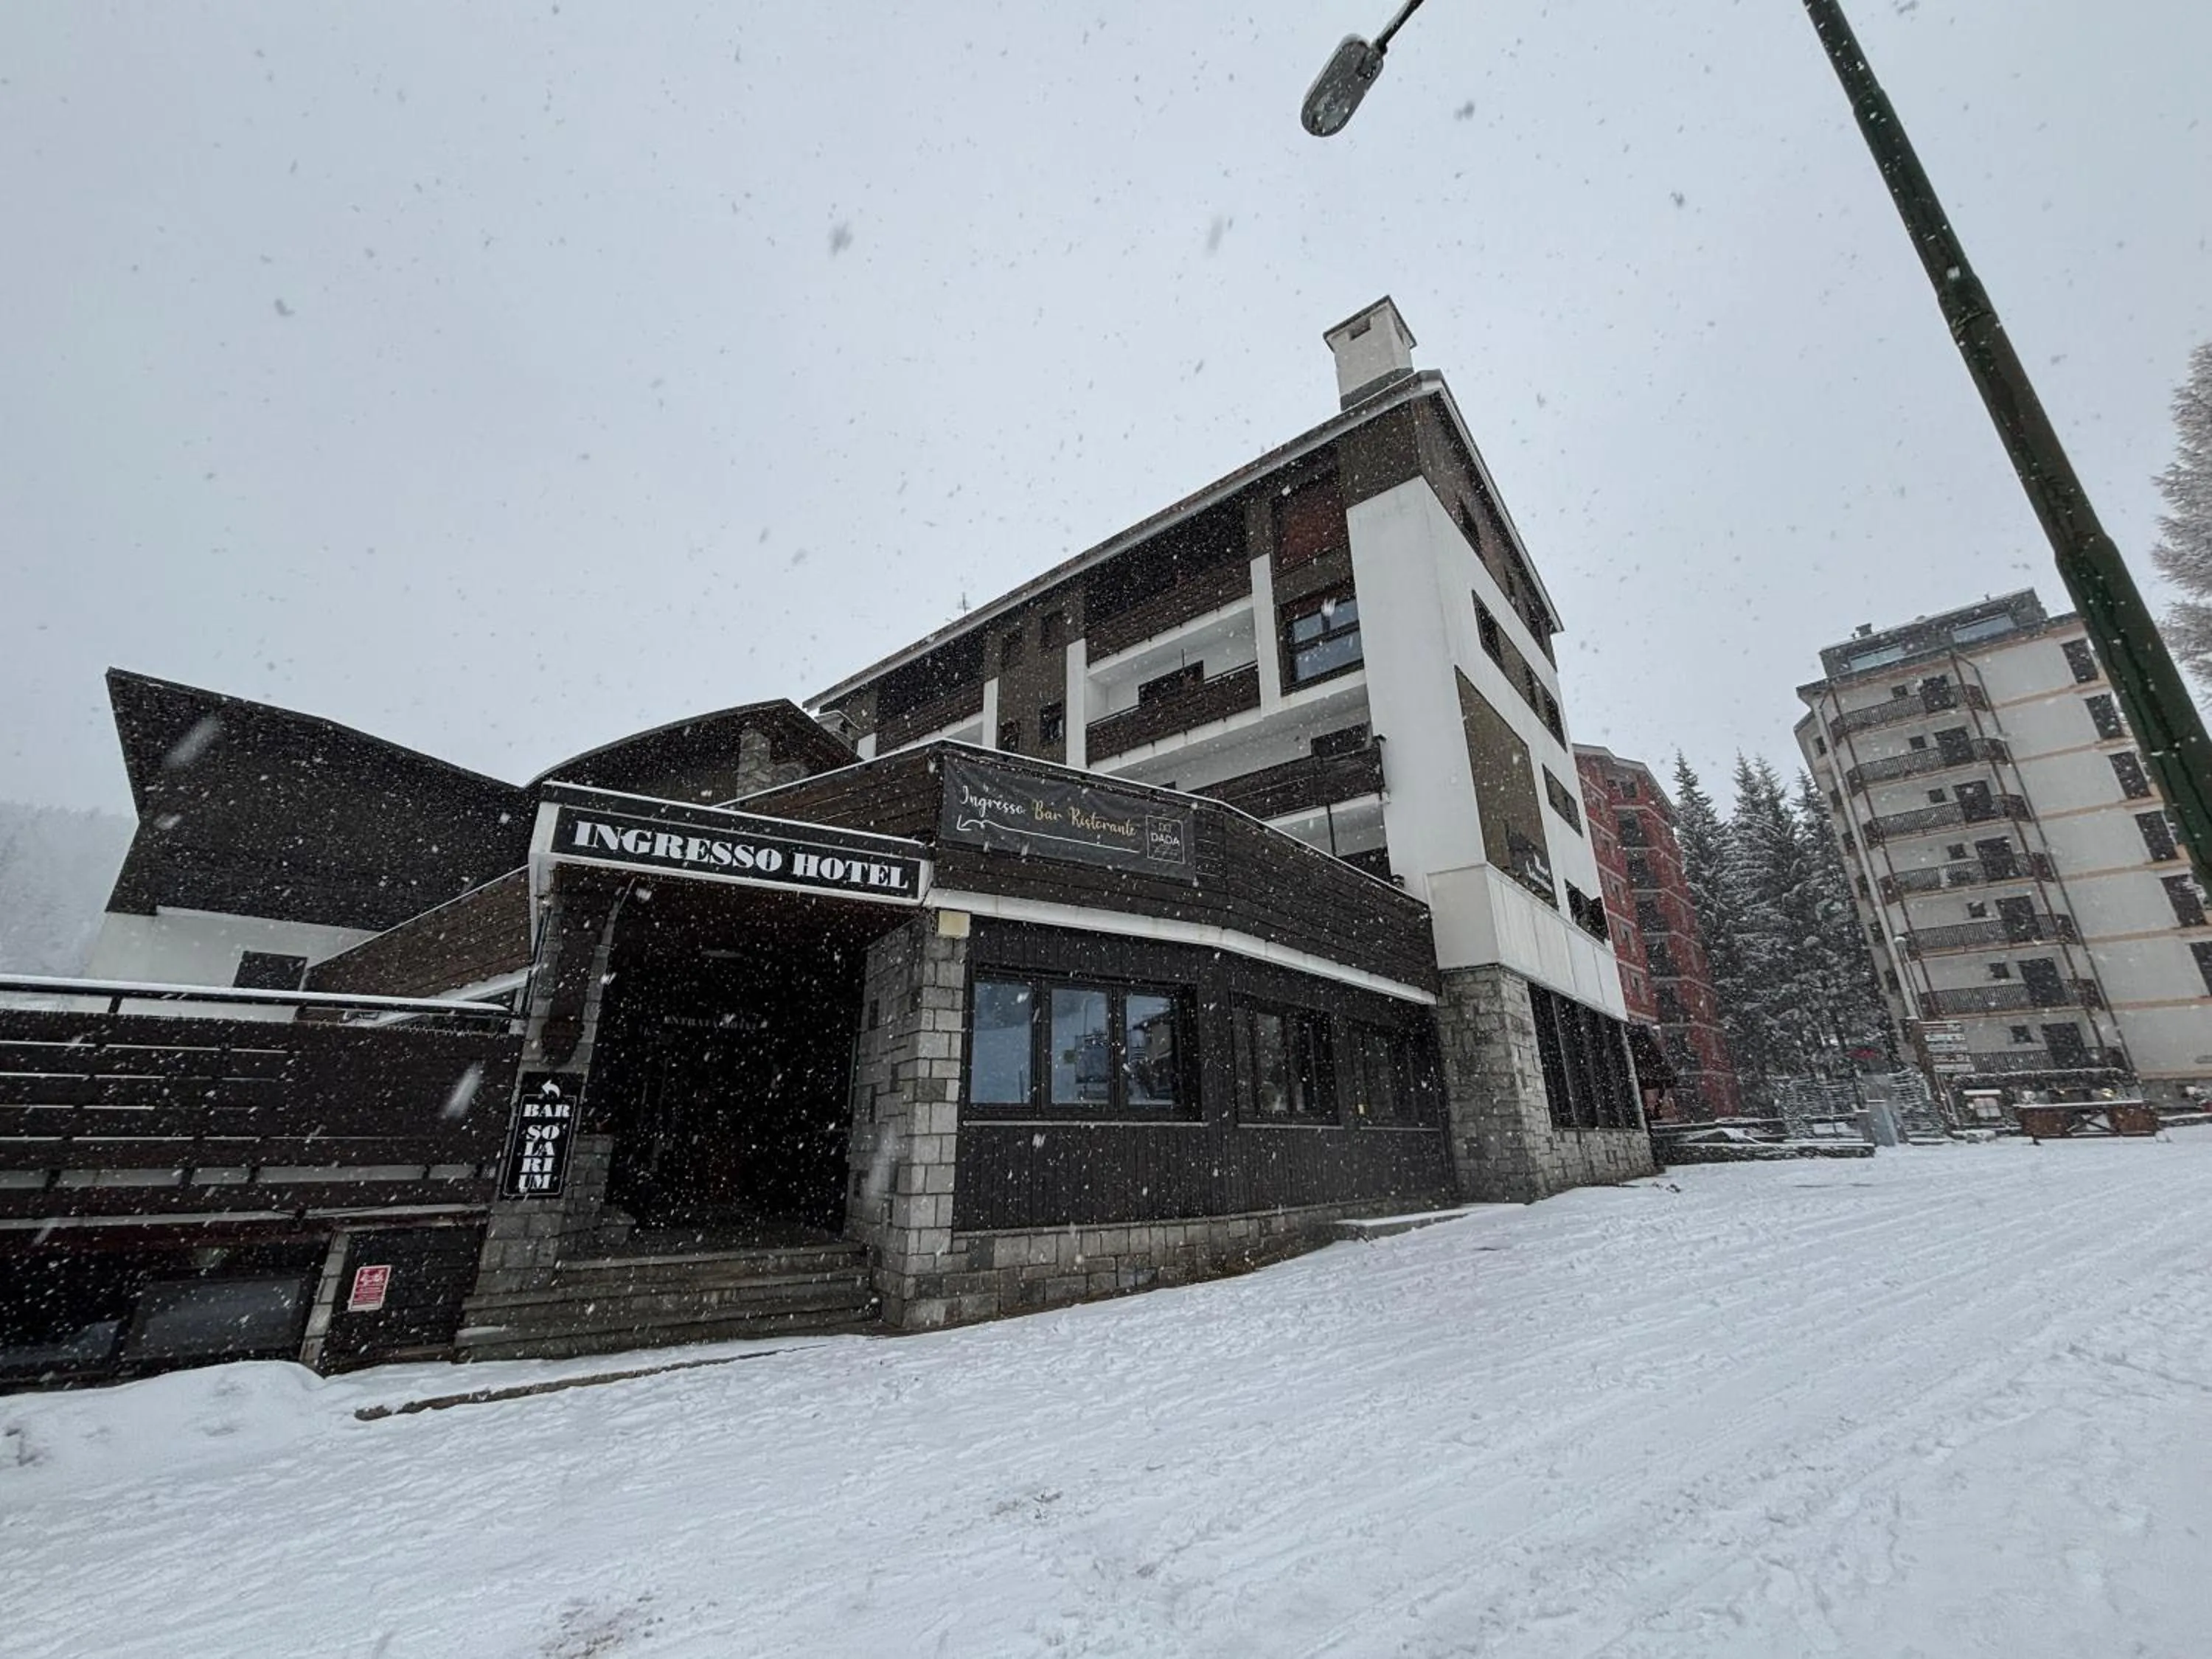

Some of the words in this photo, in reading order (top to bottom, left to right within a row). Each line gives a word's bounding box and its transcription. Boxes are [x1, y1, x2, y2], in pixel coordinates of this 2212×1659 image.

[960, 785, 1025, 816] Ingresso
[1032, 801, 1062, 821] Bar
[1070, 807, 1138, 836] Ristorante
[1150, 832, 1180, 846] DADA
[574, 821, 782, 872] INGRESSO
[792, 852, 908, 889] HOTEL
[523, 1104, 570, 1117] BAR
[526, 1124, 560, 1141] SO
[524, 1141, 555, 1156] LA
[521, 1158, 554, 1172] RI
[518, 1175, 552, 1191] UM
